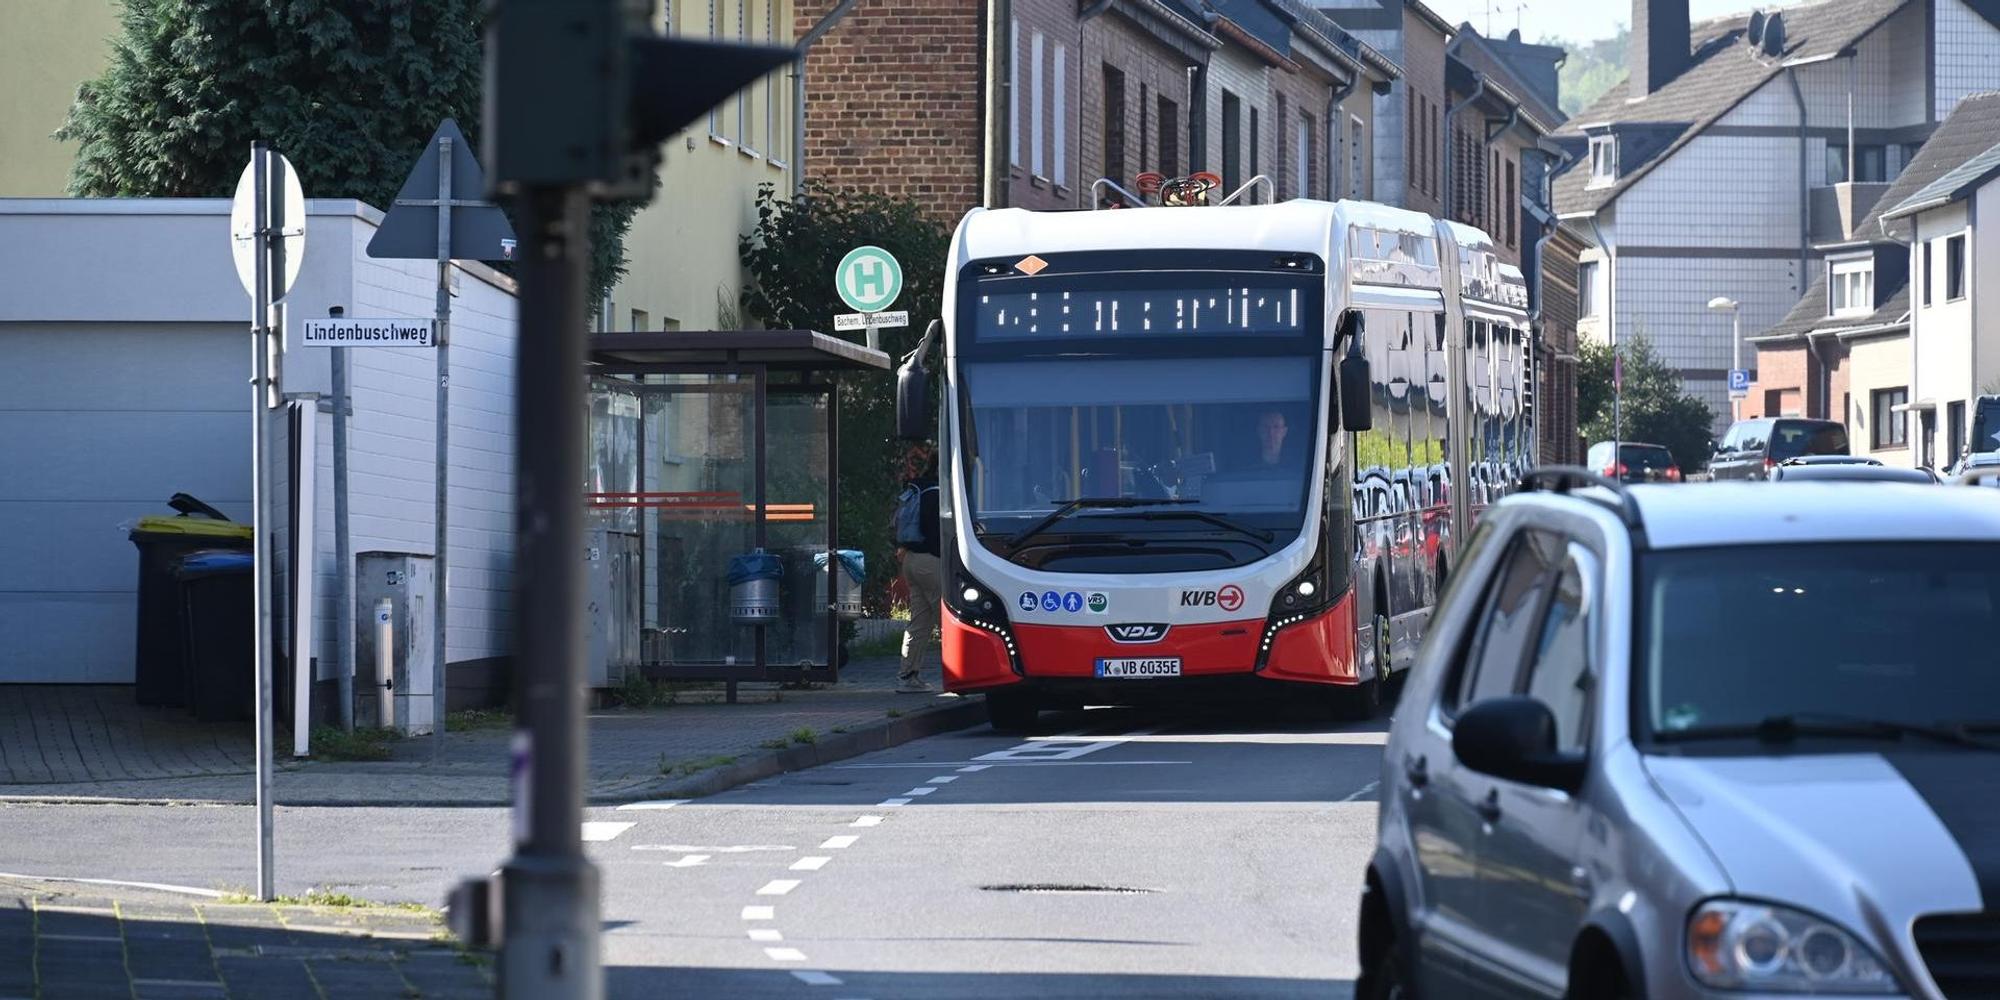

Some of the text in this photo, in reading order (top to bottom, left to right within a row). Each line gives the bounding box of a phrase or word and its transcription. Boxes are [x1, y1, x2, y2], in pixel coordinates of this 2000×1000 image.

[854, 262, 885, 297] H
[306, 323, 427, 344] Lindenbuschweg
[1733, 372, 1744, 389] P
[1180, 590, 1217, 606] KVB
[1116, 626, 1158, 637] VDL
[1104, 661, 1112, 675] K
[1121, 661, 1137, 675] VB
[1140, 660, 1178, 674] 6035E
